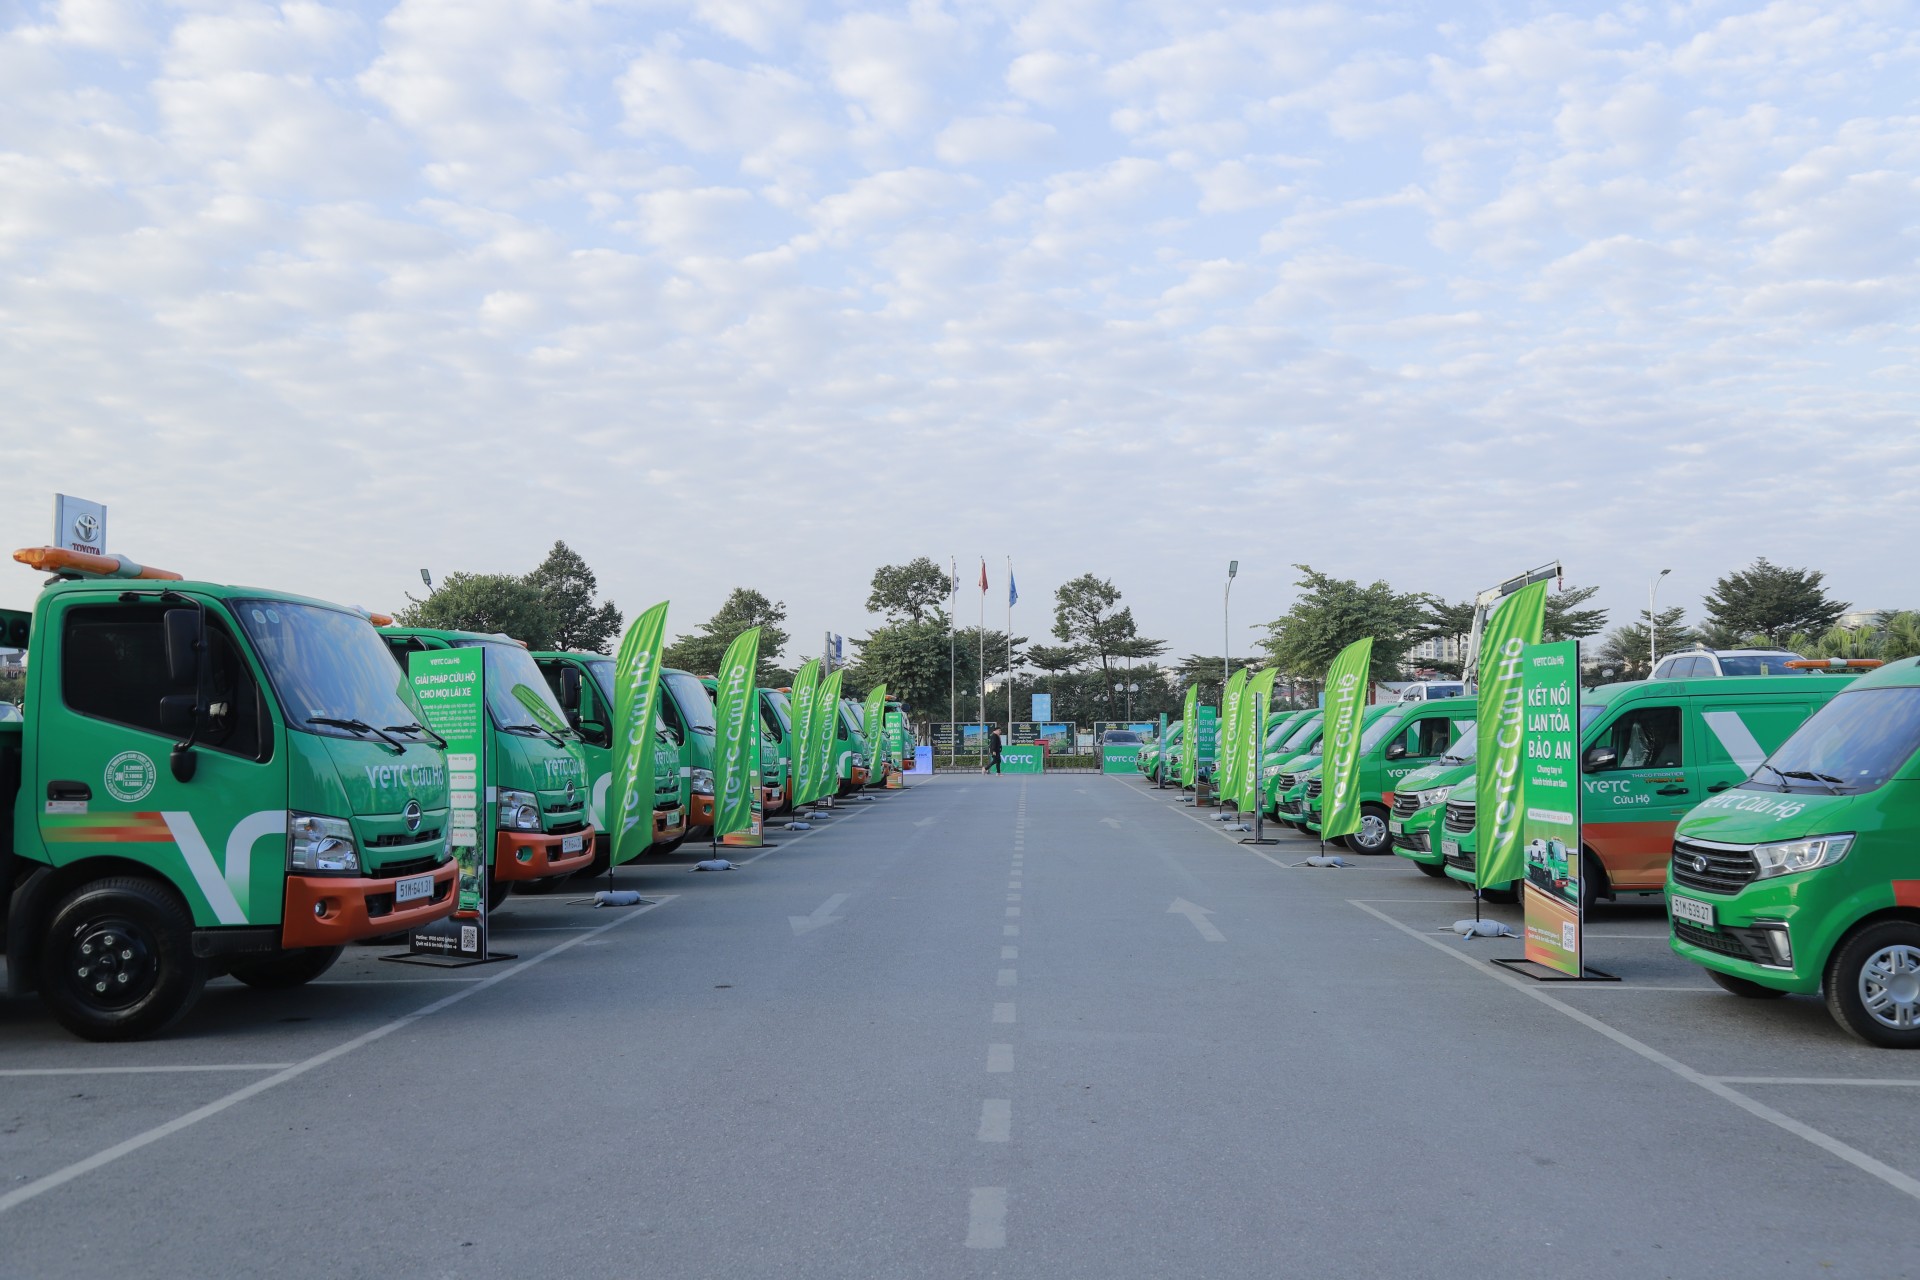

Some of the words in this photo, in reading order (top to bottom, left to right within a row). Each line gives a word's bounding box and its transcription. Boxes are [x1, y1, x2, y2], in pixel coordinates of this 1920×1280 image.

[72, 542, 100, 555] TOYOTA
[415, 673, 428, 684] GIẢI
[430, 673, 448, 684] PHÁP
[449, 671, 464, 682] CỨU
[465, 670, 476, 684] HỘ
[420, 690, 435, 698] CHO
[436, 688, 449, 700] MỌI
[451, 686, 460, 697] LÁI
[462, 687, 471, 696] XE
[1528, 682, 1547, 706] KẾT
[1550, 680, 1571, 706] NỐI
[1529, 714, 1548, 732] LAN
[1549, 708, 1571, 732] TỎA
[1528, 734, 1551, 760] BẢO
[1555, 741, 1571, 760] AN
[411, 763, 431, 786] Cứu
[432, 764, 444, 790] Hộ
[1613, 795, 1633, 804] Cứu
[1635, 794, 1650, 804] Hộ
[1773, 800, 1806, 822] Hộ
